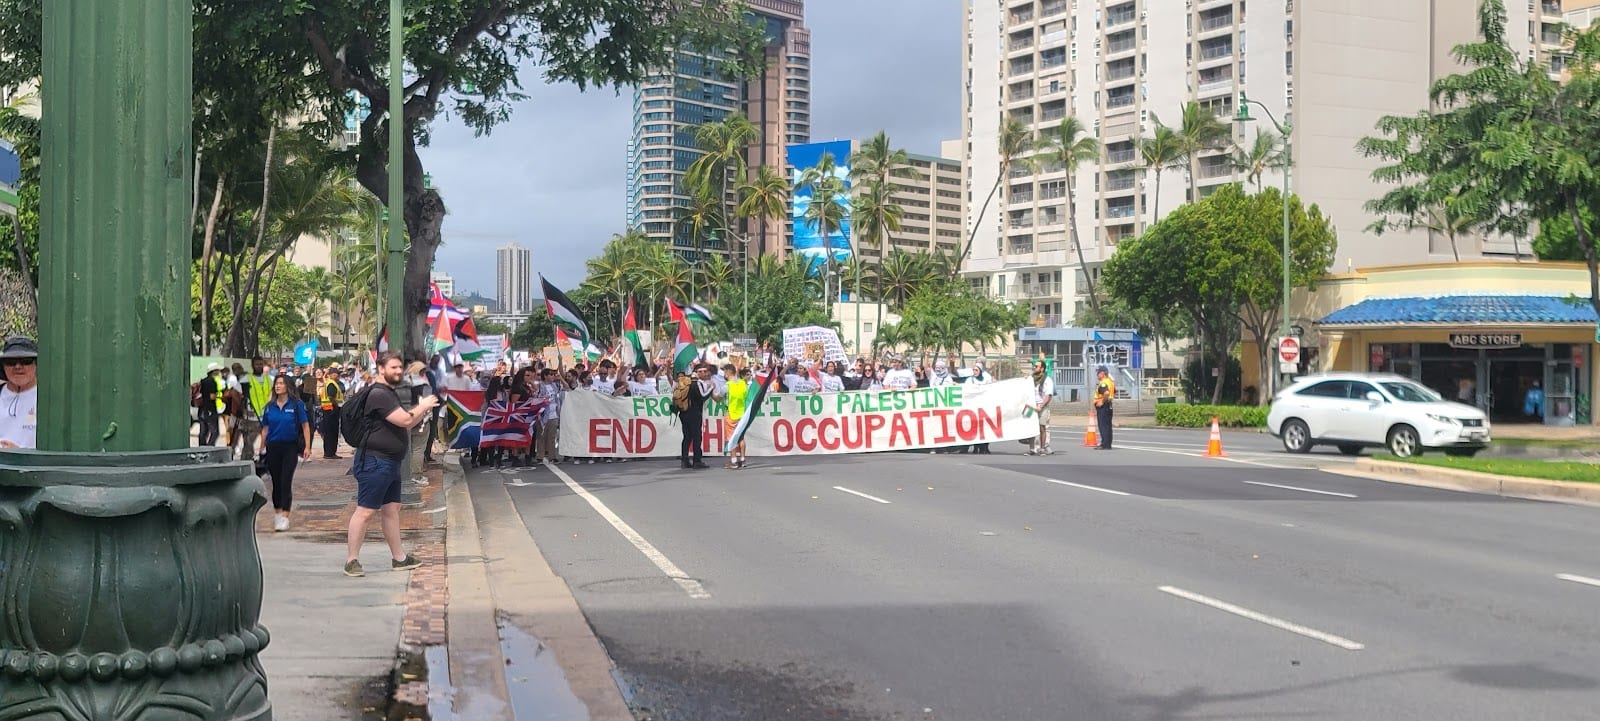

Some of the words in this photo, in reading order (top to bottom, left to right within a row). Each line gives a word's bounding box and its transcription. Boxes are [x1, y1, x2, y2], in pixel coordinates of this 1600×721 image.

[1454, 335, 1477, 345] ABC
[1479, 335, 1518, 345] STORE
[632, 398, 673, 417] FRO
[796, 394, 824, 416] TO
[836, 386, 963, 414] PALESTINE
[589, 418, 656, 454] END
[773, 406, 1003, 452] OCCUPATION
